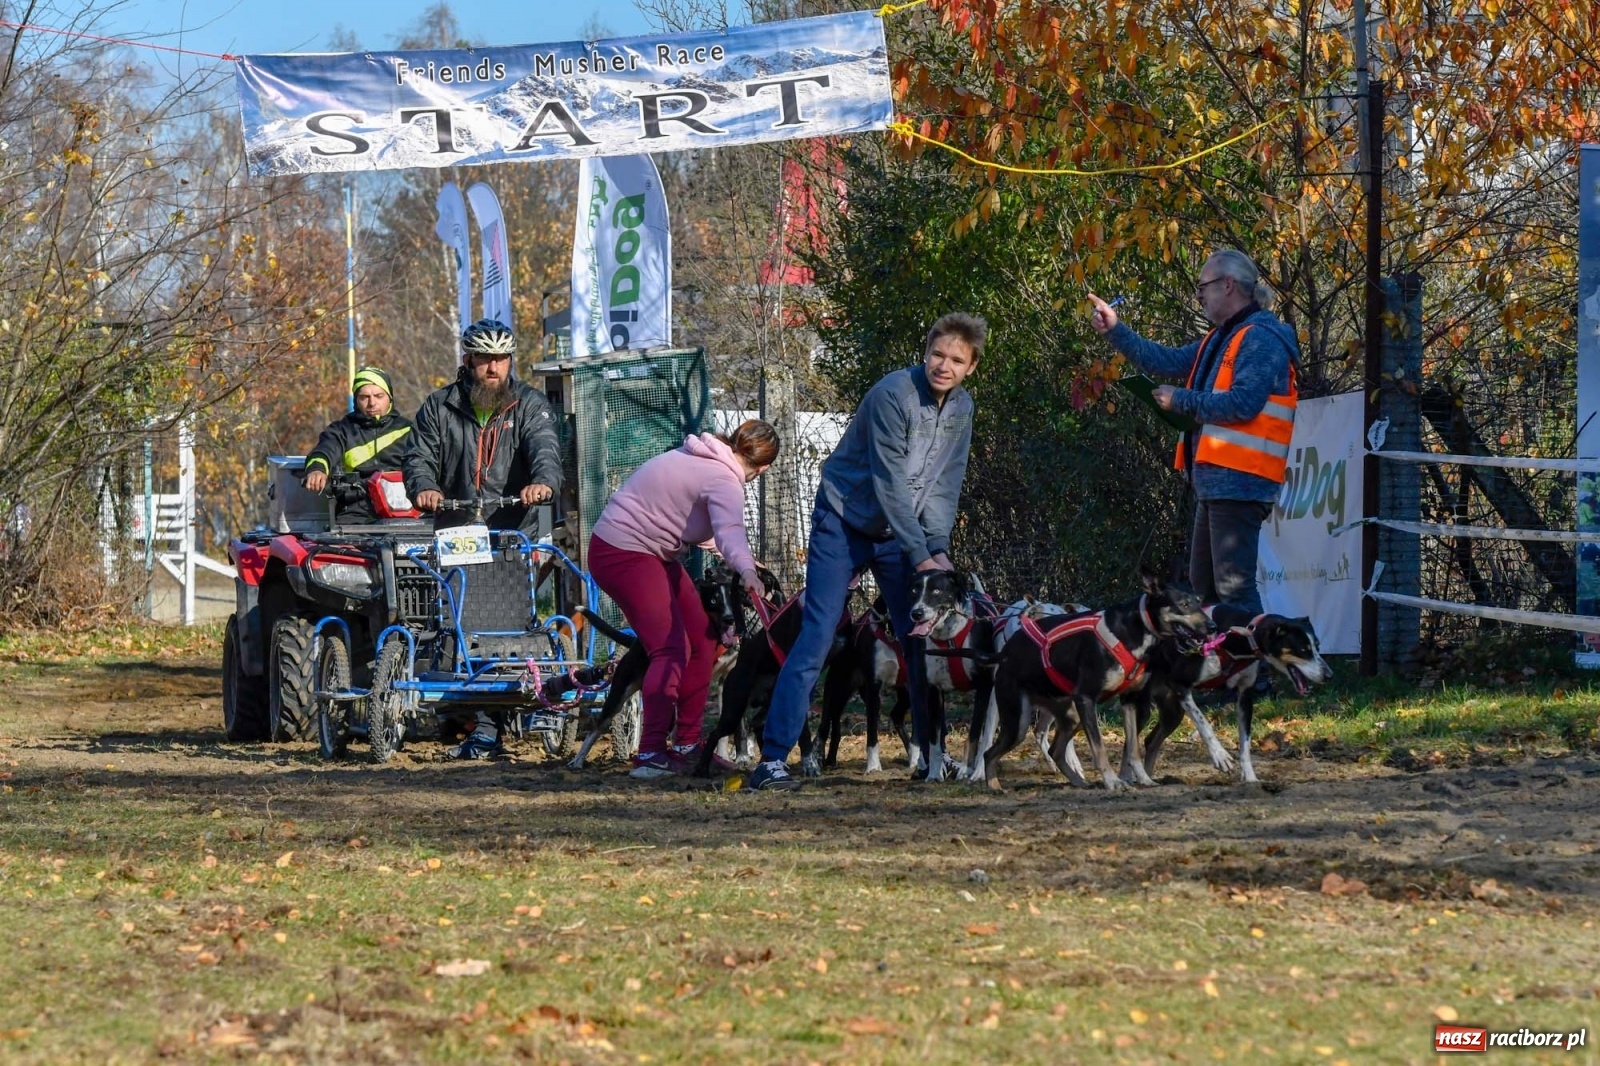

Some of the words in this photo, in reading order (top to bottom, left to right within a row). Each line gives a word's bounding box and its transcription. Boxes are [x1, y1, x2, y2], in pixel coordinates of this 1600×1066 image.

[396, 57, 506, 85] Friends
[534, 51, 640, 77] Musher
[656, 44, 725, 67] Race
[304, 74, 830, 156] START
[451, 536, 478, 555] 35
